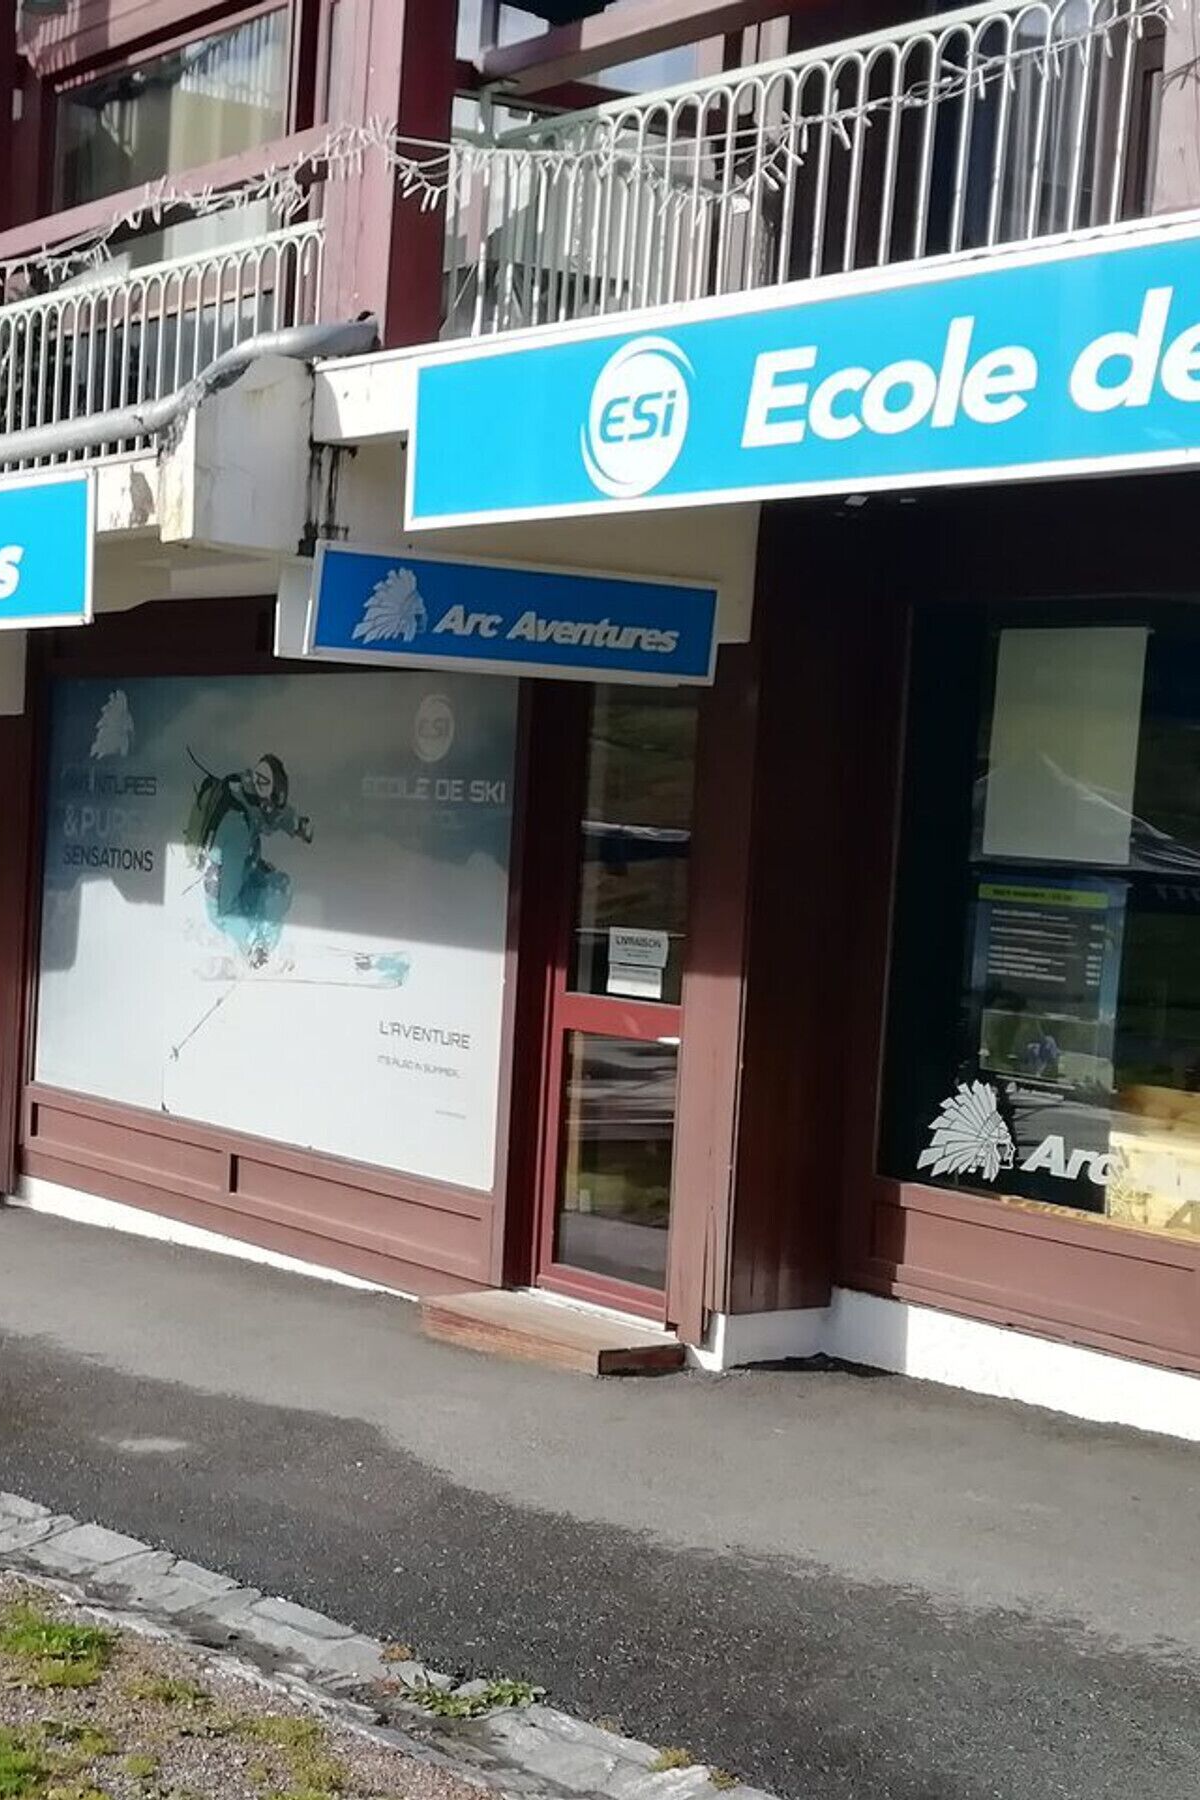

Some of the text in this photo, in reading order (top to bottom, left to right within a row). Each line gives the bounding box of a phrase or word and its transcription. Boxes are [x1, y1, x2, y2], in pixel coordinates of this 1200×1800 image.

[740, 315, 1038, 449] Ecole
[433, 605, 680, 654] Arc Aventures
[435, 778, 466, 802] DE
[469, 780, 506, 804] SKI
[62, 843, 154, 873] SENSATIONS
[379, 1020, 470, 1049] L'AVENTURE
